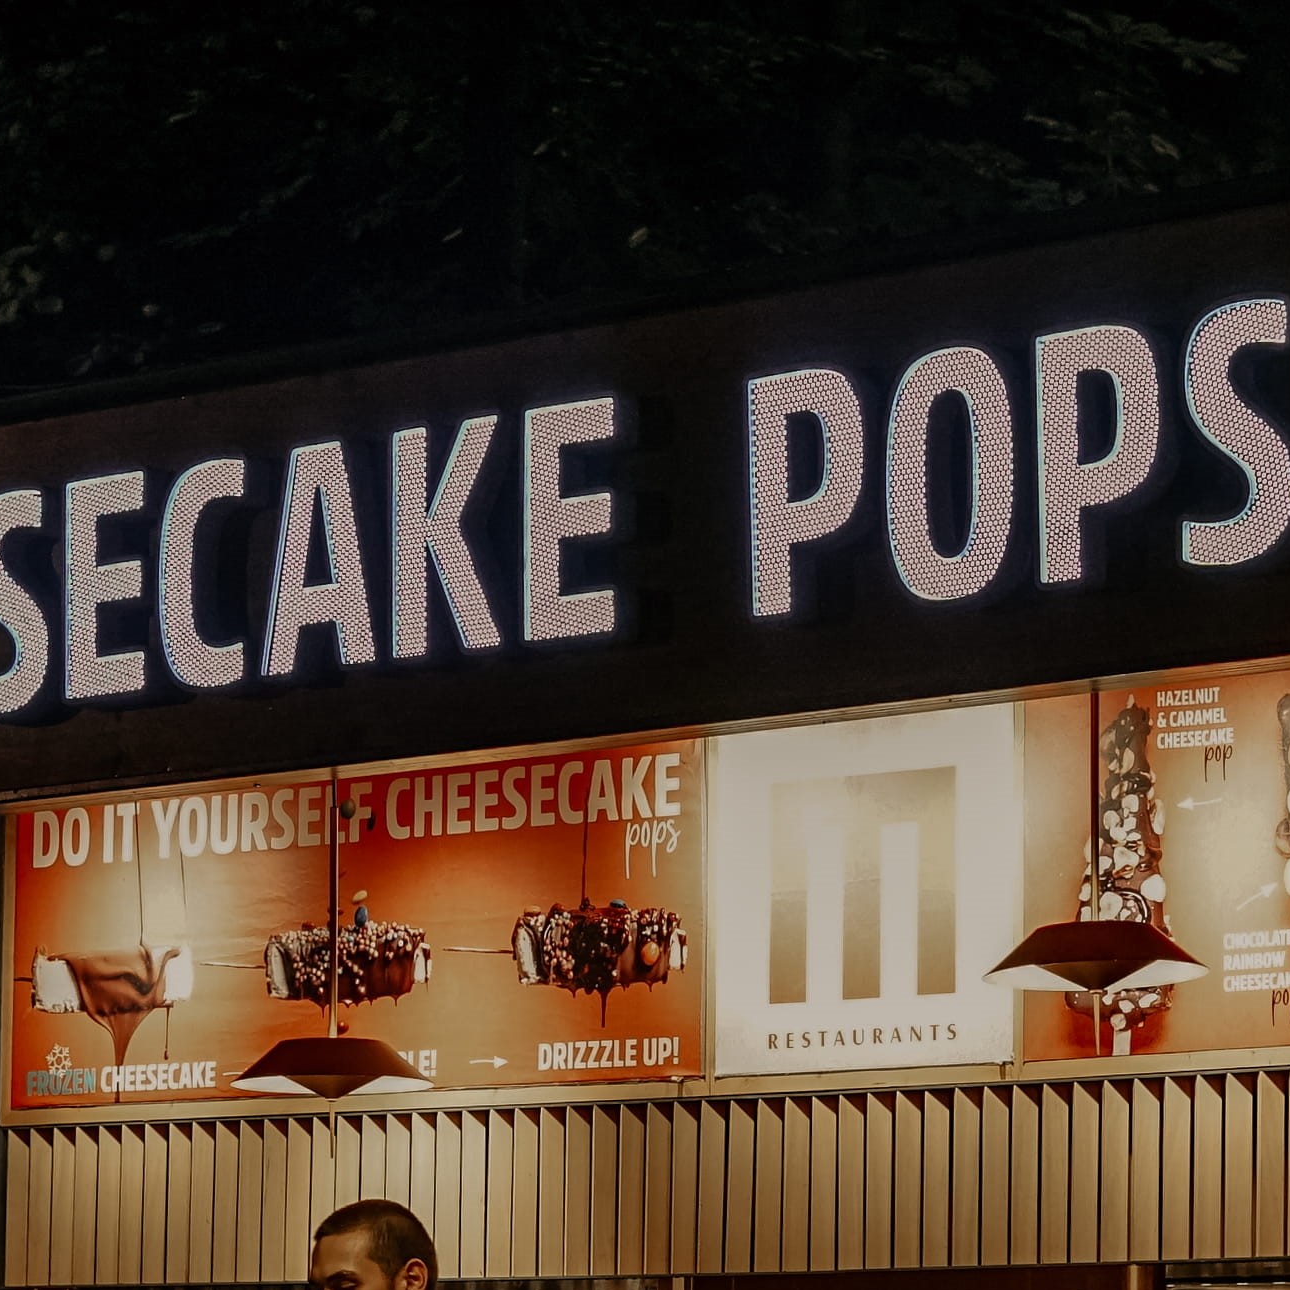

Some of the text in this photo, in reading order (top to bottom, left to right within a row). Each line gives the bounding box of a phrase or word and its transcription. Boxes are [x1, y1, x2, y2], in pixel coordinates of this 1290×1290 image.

[1157, 687, 1221, 708] HAZELNUT
[1157, 706, 1228, 728] & CARAMEL
[1157, 727, 1234, 750] CHEESECAKE
[1204, 744, 1234, 783] pop
[33, 753, 681, 868] DO IT YOURSELF CHEESECAKE
[625, 815, 681, 879] pops
[1223, 949, 1287, 972] RAINBOW
[768, 1023, 958, 1050] RESTAURANTS
[537, 1036, 680, 1071] DRIZZZLE UP!
[26, 1060, 218, 1097] FROZEN CHEESECAKE
